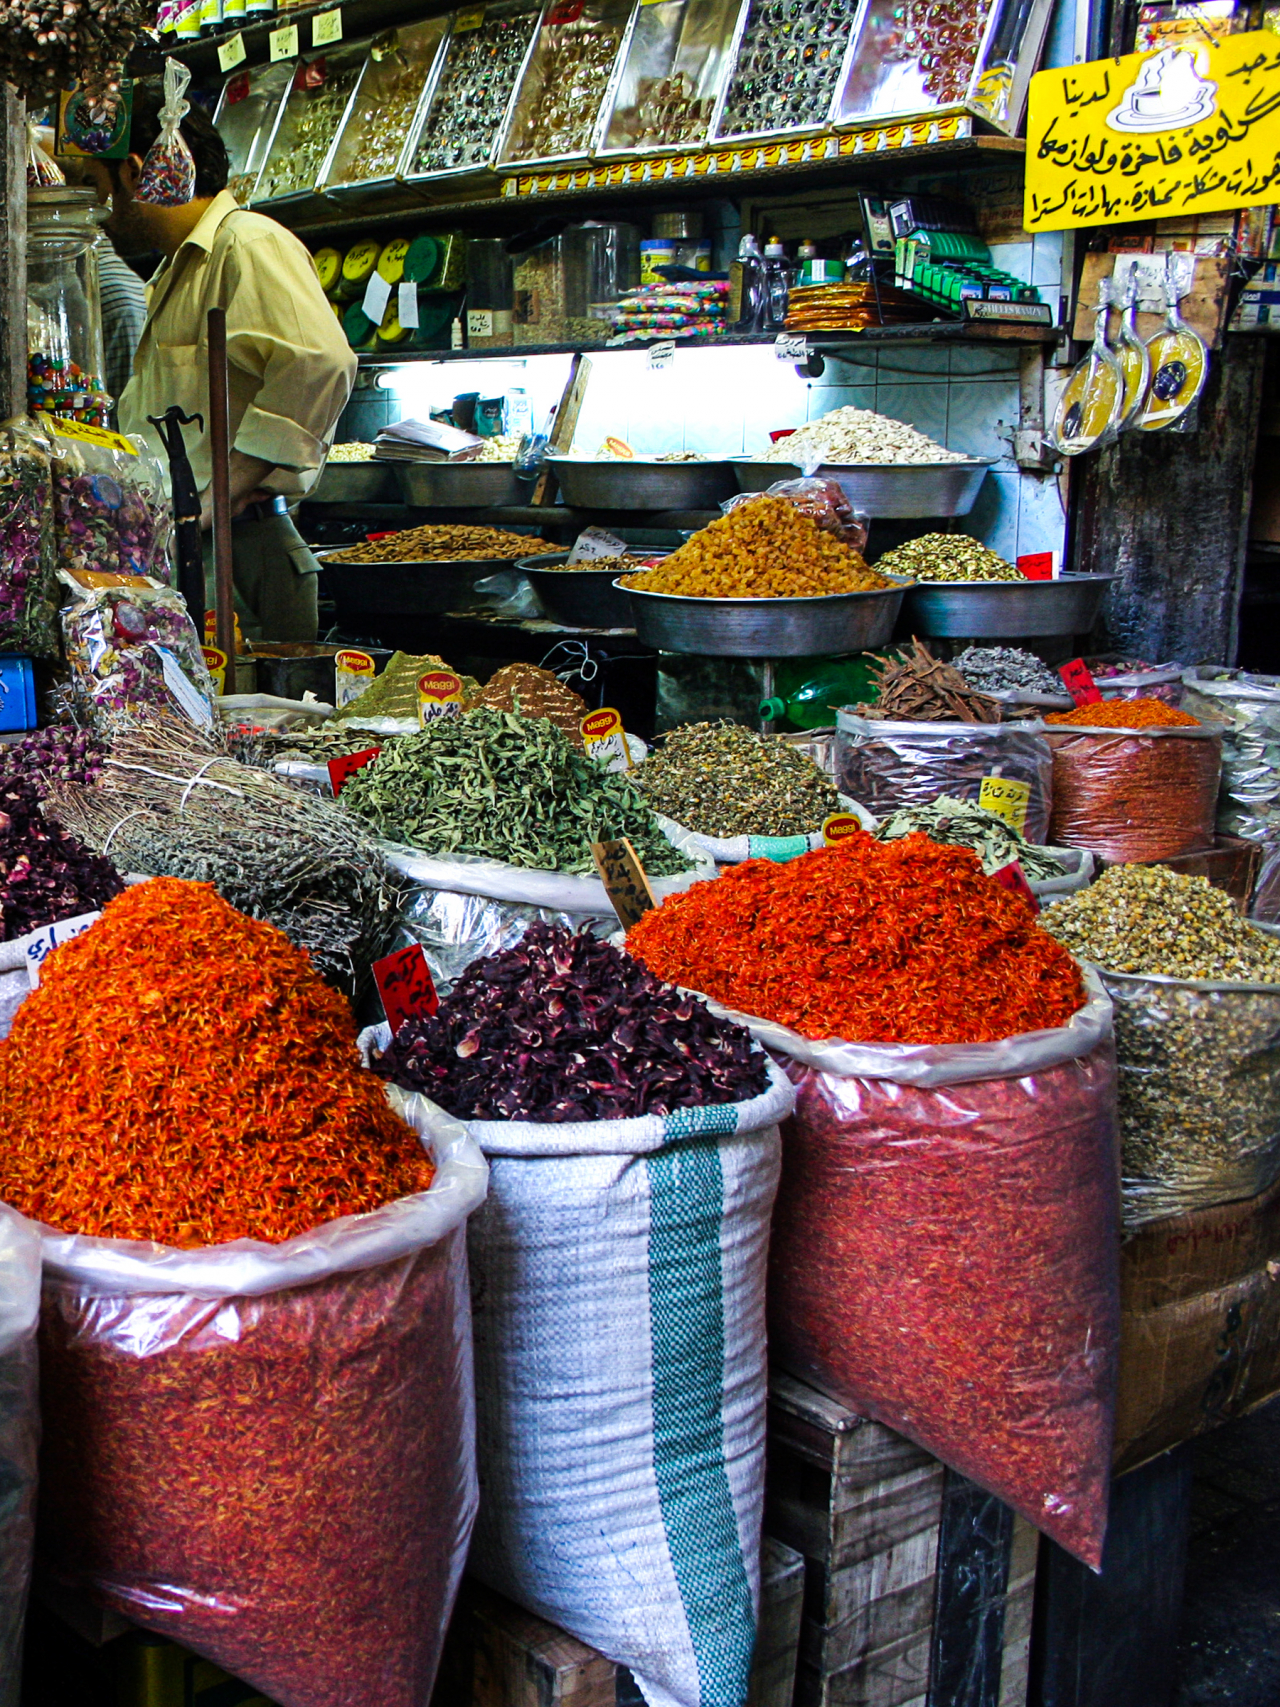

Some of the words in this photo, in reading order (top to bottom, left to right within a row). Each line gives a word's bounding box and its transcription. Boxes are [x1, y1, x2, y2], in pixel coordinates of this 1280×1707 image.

[1226, 52, 1280, 85] وجد
[1063, 71, 1110, 118] لدينا
[1120, 136, 1183, 177] فاخرة
[1226, 151, 1280, 197] هورات
[205, 655, 218, 667] ggi
[342, 656, 368, 668] Maggi
[424, 680, 455, 690] Maggi
[586, 714, 613, 732] Maggi
[829, 823, 856, 836] Maggi
